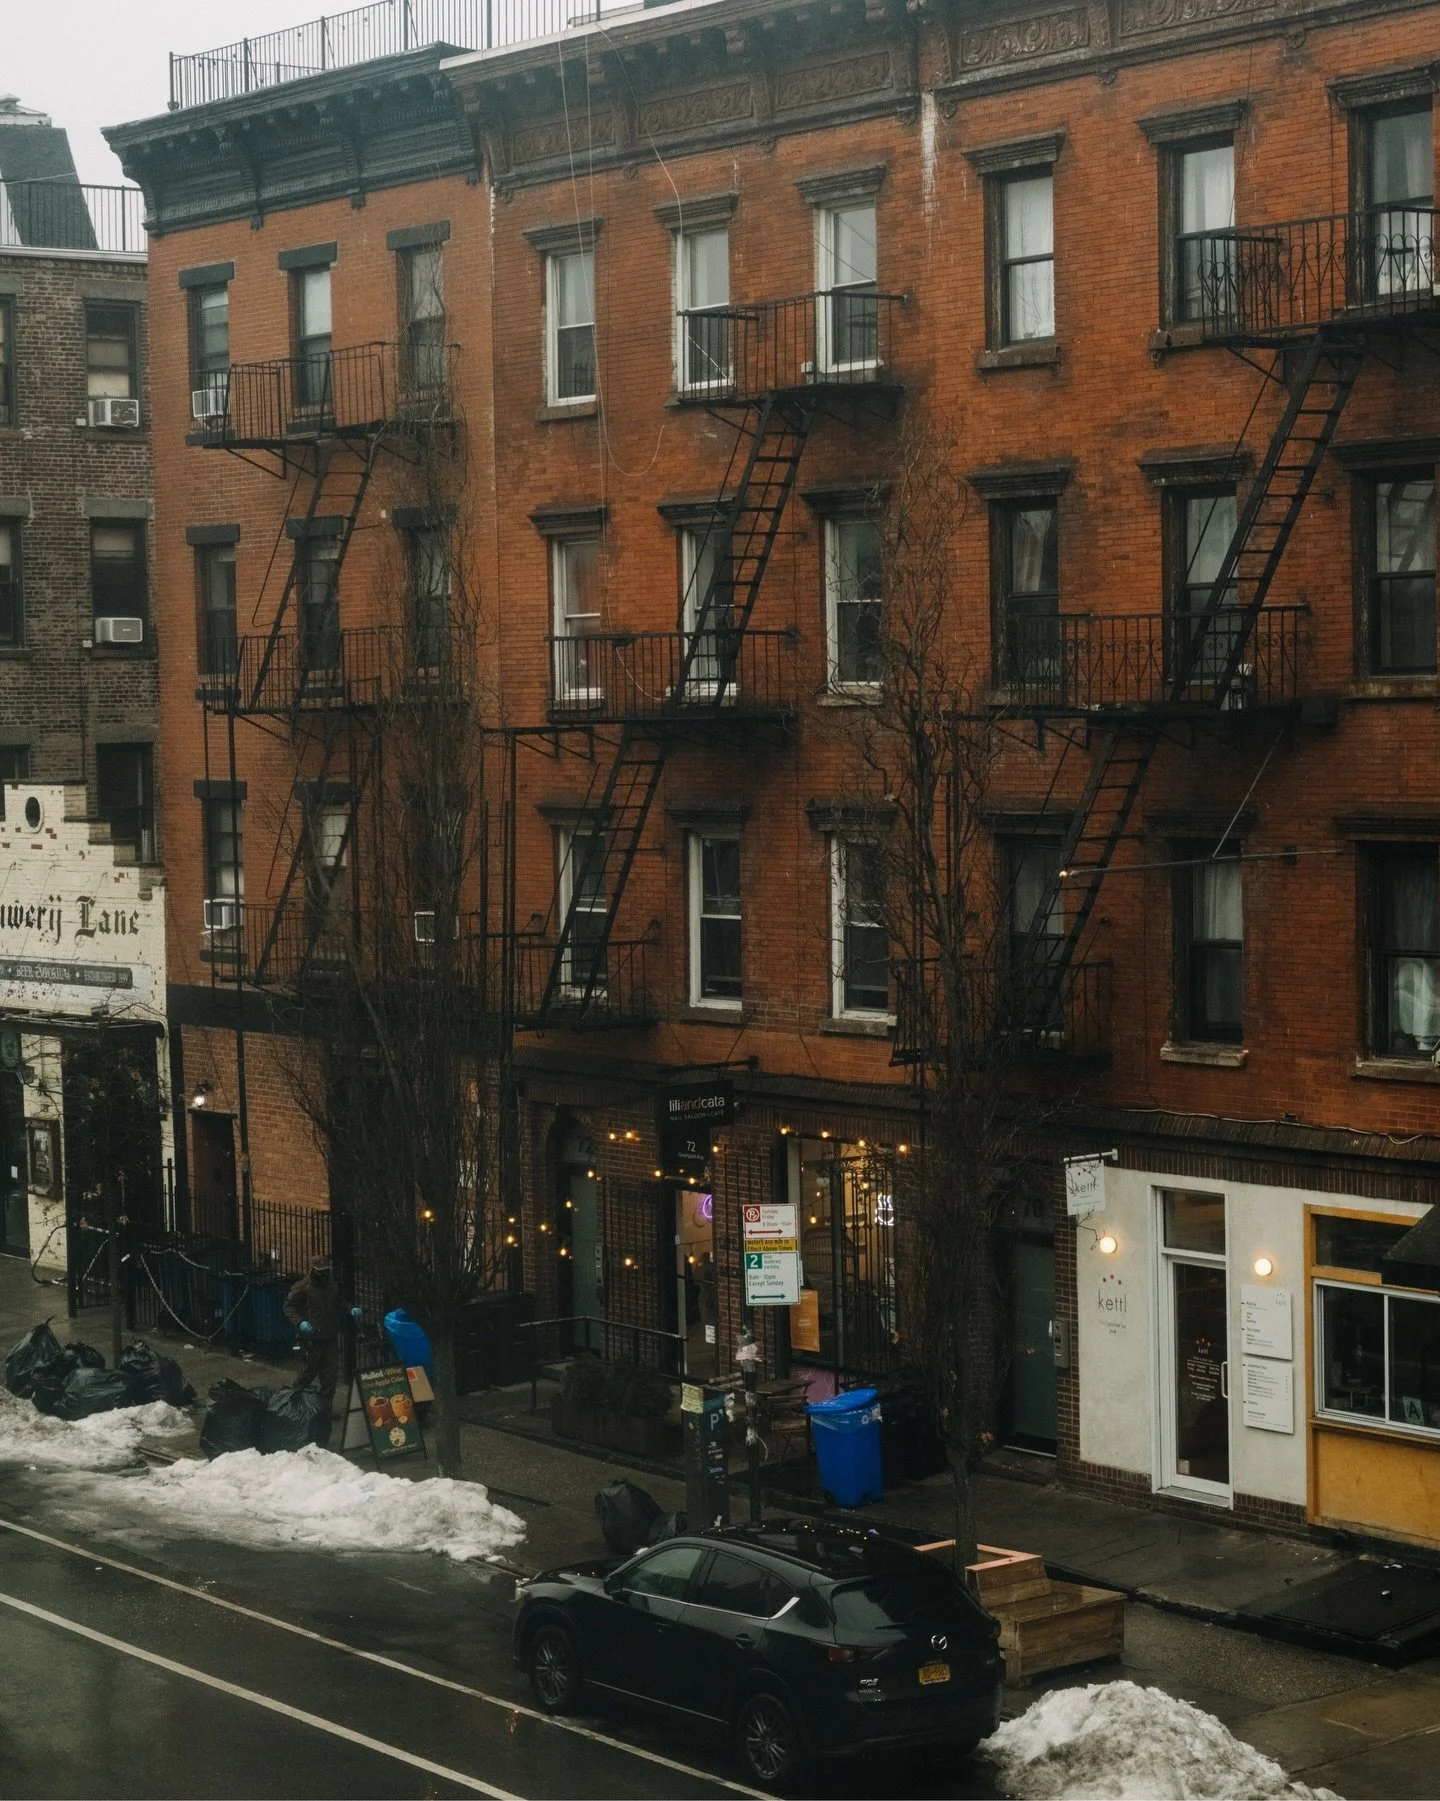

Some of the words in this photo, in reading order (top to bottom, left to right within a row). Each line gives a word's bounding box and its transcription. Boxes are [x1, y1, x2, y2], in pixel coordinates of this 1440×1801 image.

[74, 896, 139, 947] Lane
[669, 1096, 725, 1113] liliandcata
[686, 1140, 696, 1153] 72
[750, 1254, 758, 1268] 2
[1098, 1289, 1127, 1312] kettl
[1409, 1401, 1420, 1419] A
